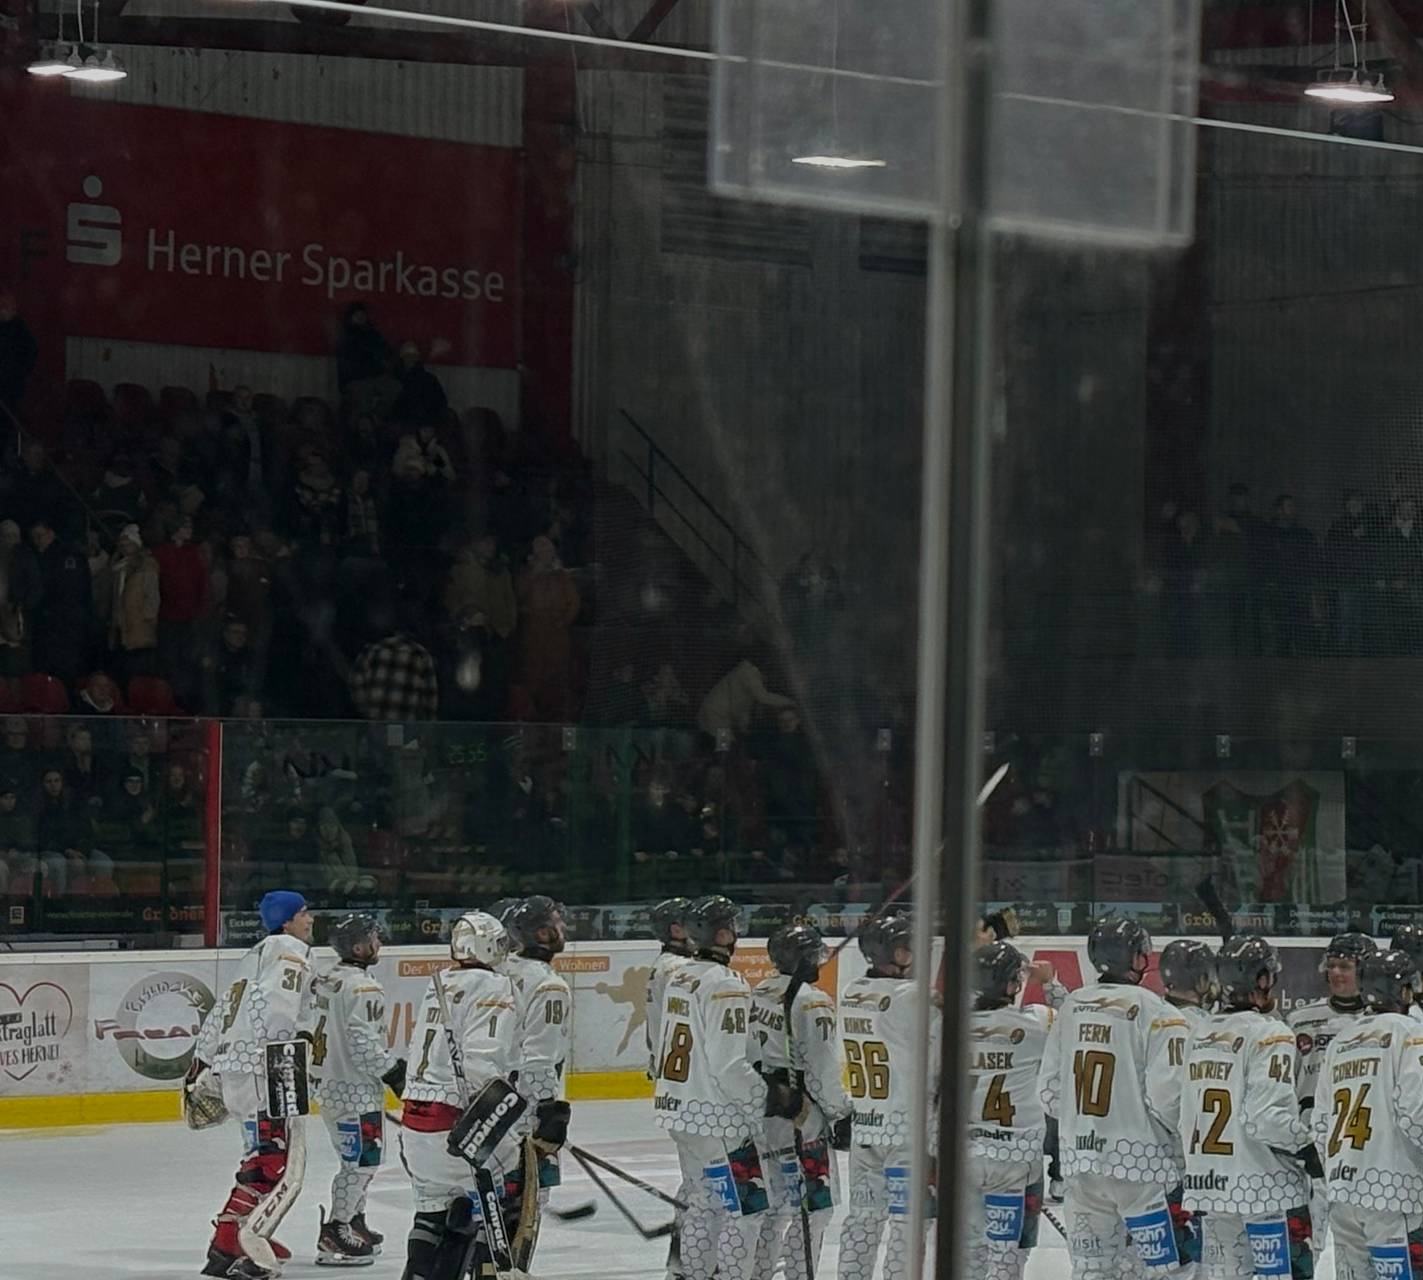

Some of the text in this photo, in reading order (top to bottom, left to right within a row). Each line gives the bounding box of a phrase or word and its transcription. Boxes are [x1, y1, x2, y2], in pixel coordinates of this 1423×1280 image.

[146, 228, 506, 302] Herner Sparkasse
[402, 962, 422, 976] Der
[559, 957, 607, 972] Wohnen
[0, 1011, 57, 1047] traglatt
[1079, 1023, 1112, 1044] FERN
